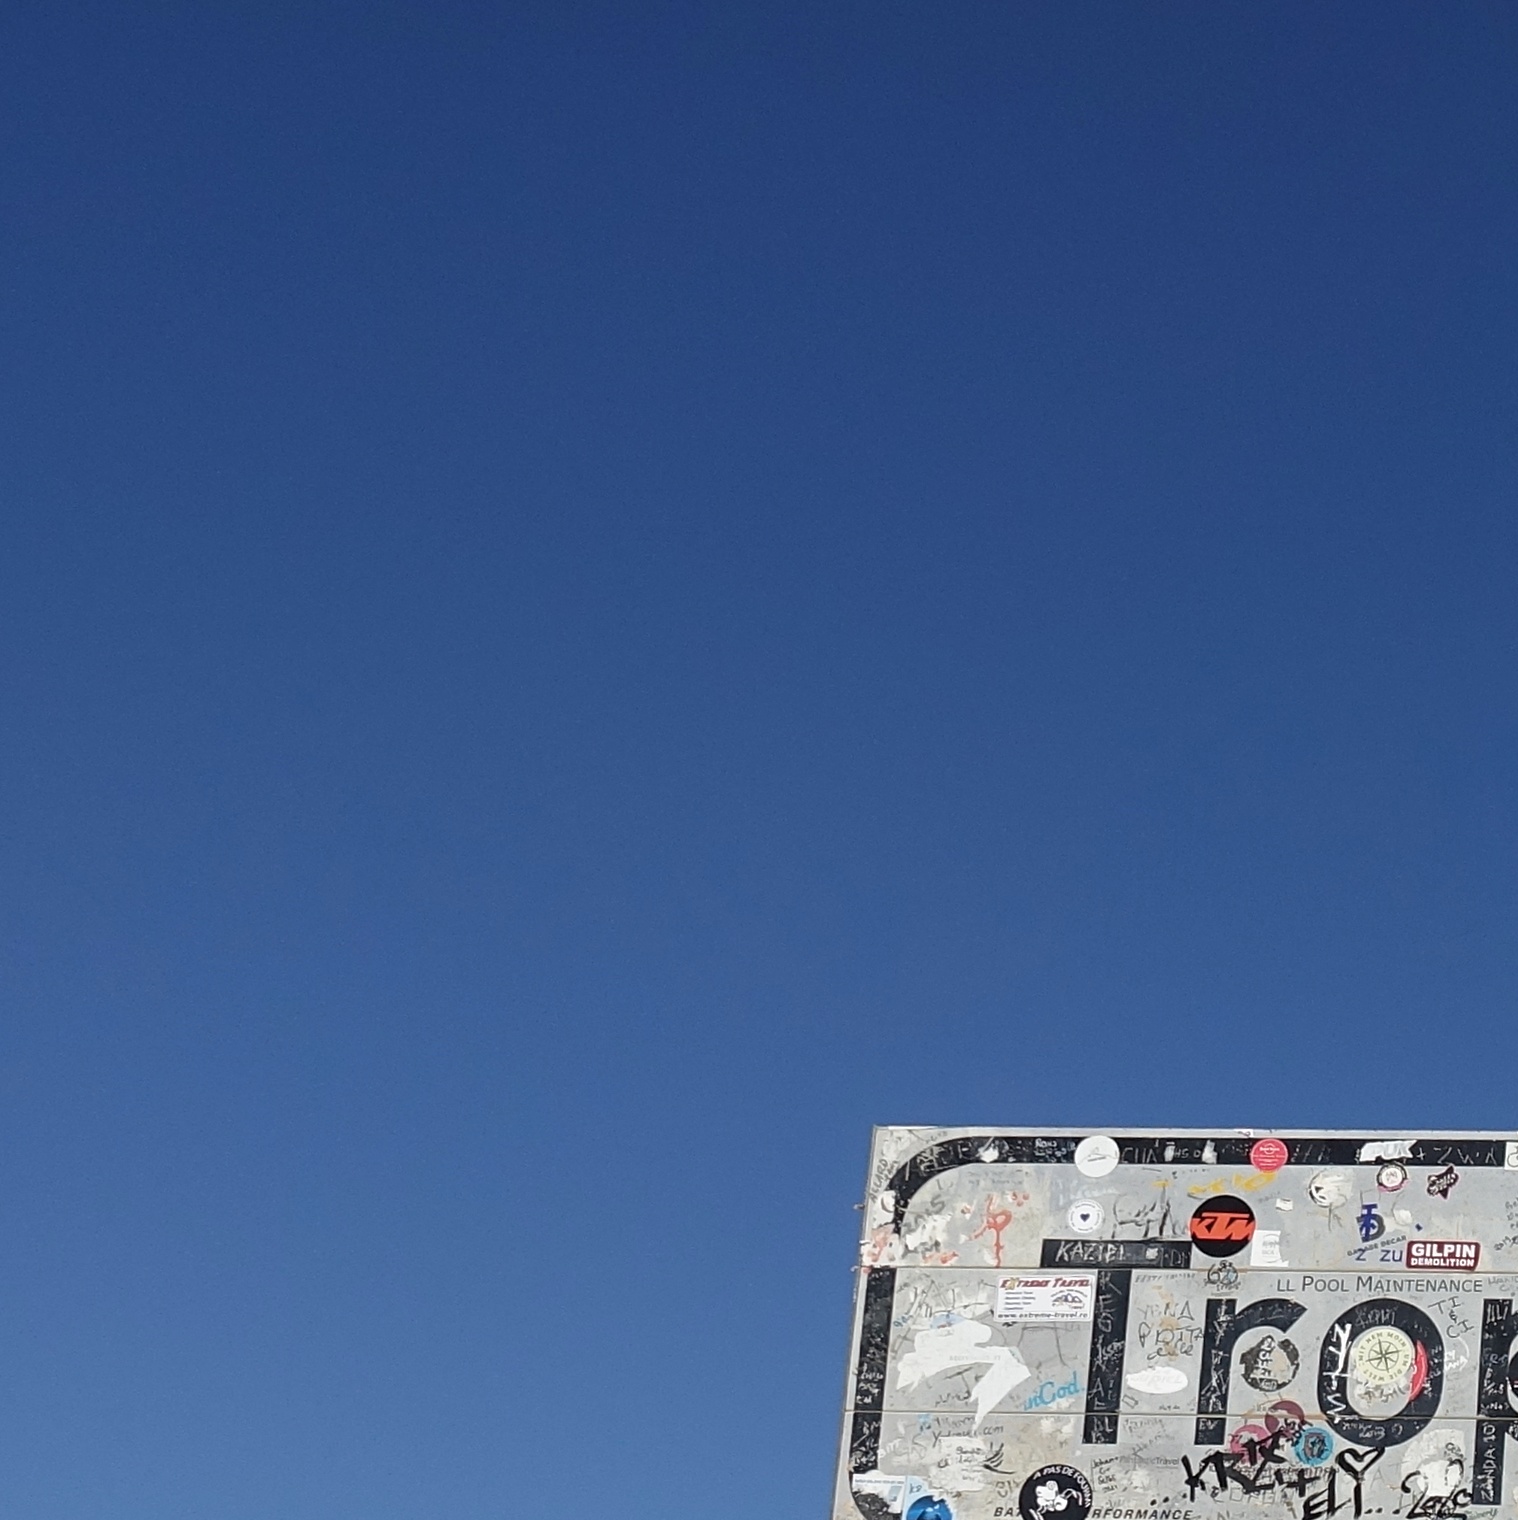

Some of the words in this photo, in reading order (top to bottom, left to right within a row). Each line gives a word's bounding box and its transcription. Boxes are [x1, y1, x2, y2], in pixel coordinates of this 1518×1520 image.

[1191, 1211, 1256, 1240] KTM
[1410, 1243, 1476, 1258] GILPIN
[1410, 1257, 1475, 1267] DEMOLITION
[1301, 1276, 1349, 1292] POOL
[1355, 1275, 1483, 1293] MAINTENANCE
[1042, 1465, 1060, 1477] PAS
[1061, 1465, 1073, 1478] DE
[1090, 1508, 1194, 1520] RFORMANCE
